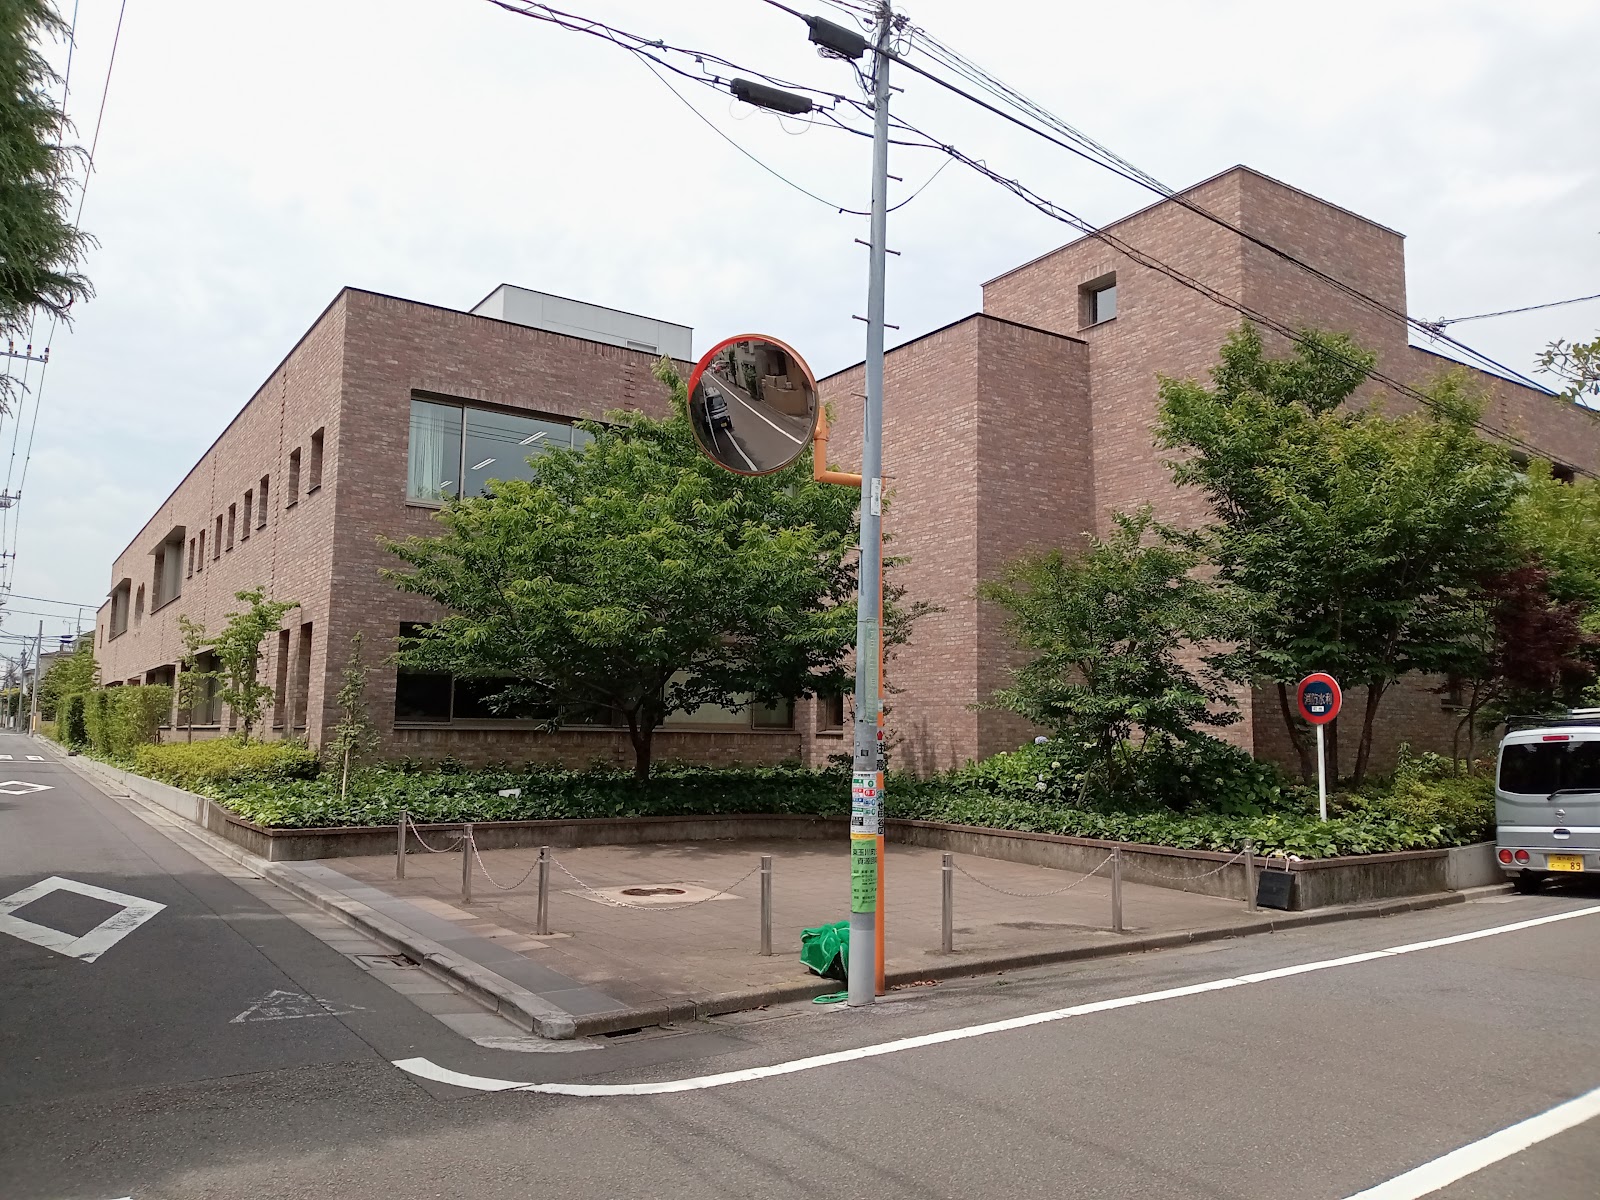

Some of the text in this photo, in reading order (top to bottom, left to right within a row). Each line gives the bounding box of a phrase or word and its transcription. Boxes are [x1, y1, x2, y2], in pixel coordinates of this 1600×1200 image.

[1304, 692, 1333, 705] 消防水利
[876, 742, 885, 771] 注意
[877, 802, 885, 834] 世田谷区
